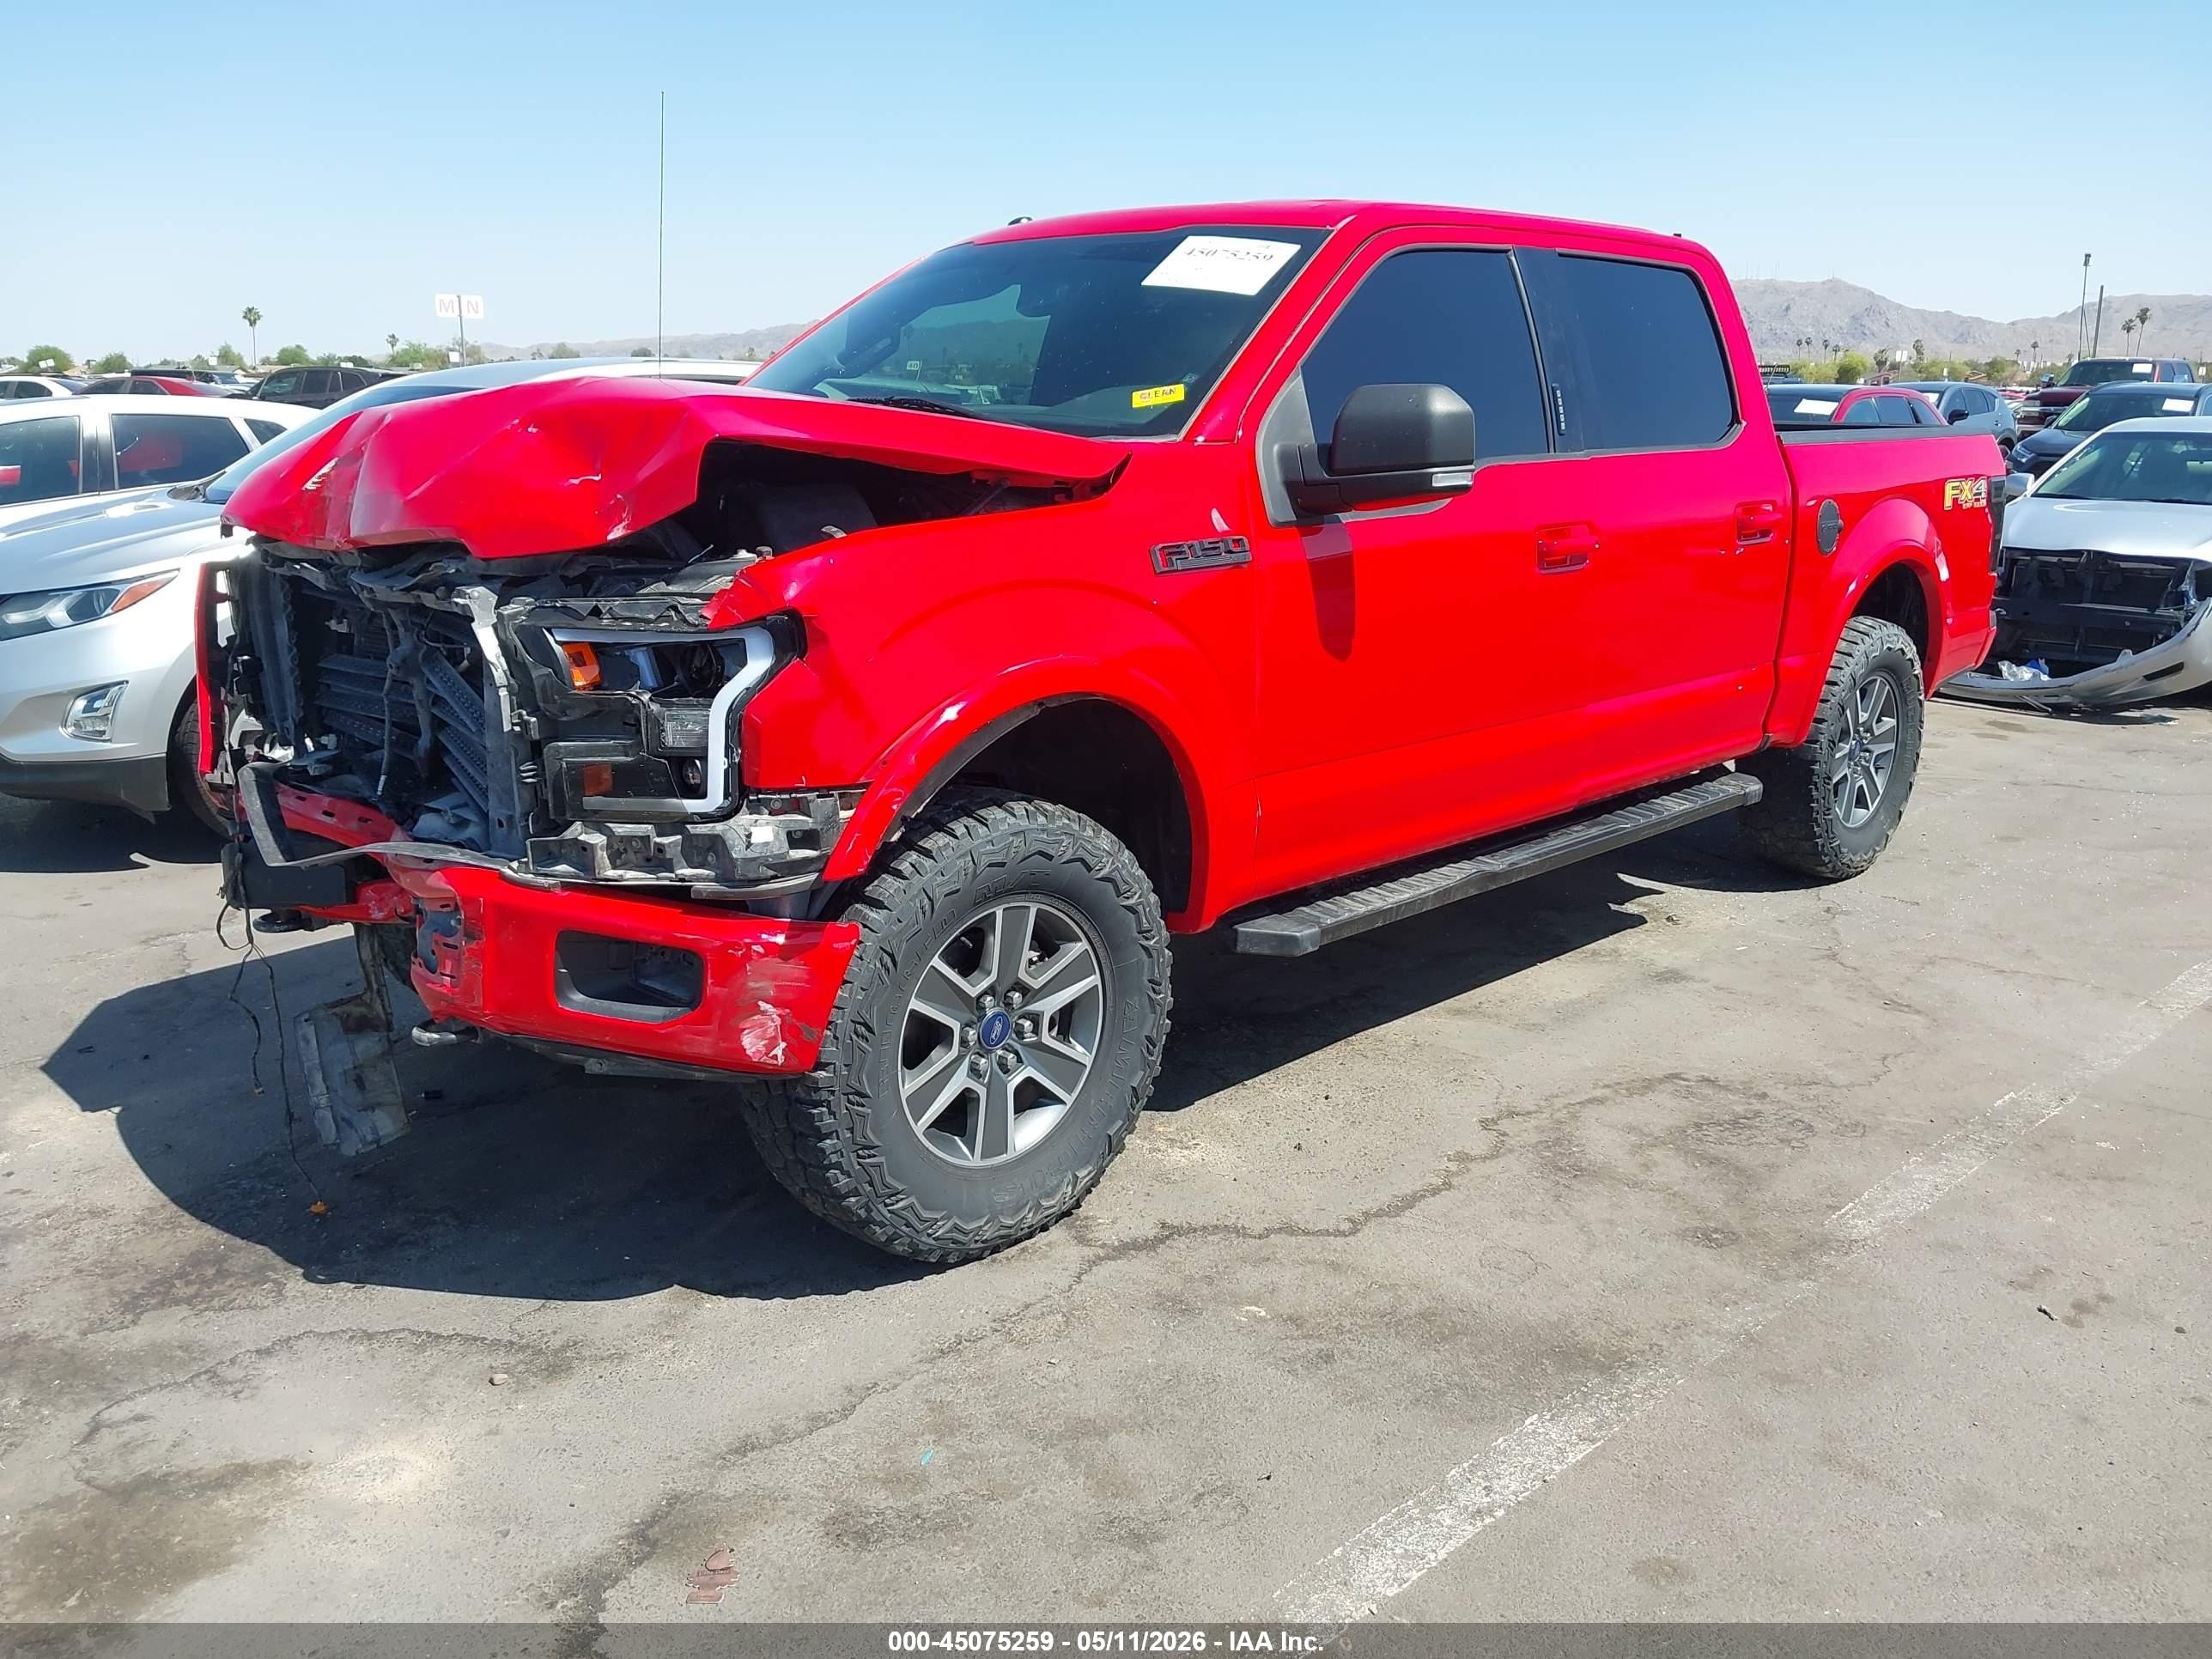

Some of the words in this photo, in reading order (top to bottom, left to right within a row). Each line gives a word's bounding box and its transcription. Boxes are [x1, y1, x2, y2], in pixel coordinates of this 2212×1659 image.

[439, 298, 455, 313] M
[466, 300, 479, 314] N
[1943, 476, 1988, 510] FX4
